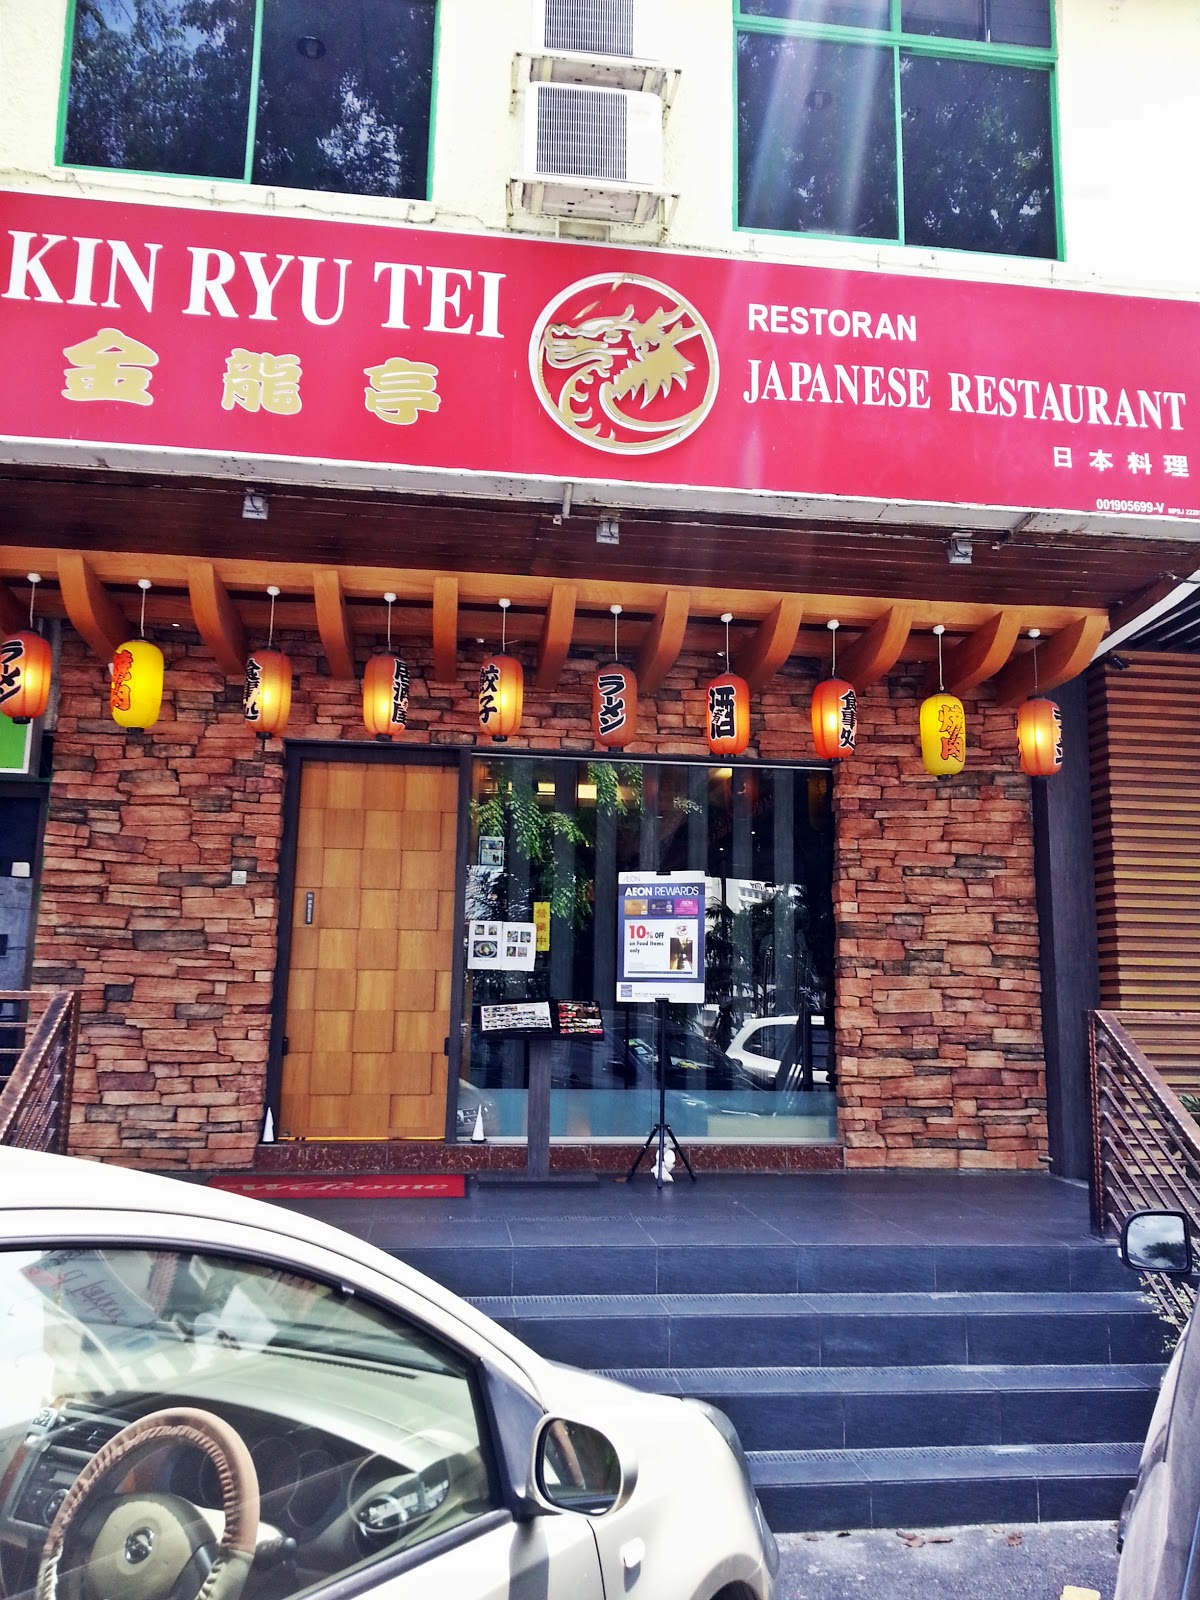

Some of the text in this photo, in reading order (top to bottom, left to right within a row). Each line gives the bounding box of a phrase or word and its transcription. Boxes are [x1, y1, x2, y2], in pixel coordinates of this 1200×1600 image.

[1, 229, 507, 339] KIN RYU TEI
[747, 303, 917, 342] RESTORAN
[60, 327, 442, 426] 金龍亭
[743, 358, 1186, 431] JAPANESE RESTAURANT
[1053, 446, 1190, 478] 日本料理
[596, 673, 627, 736] ラーメン
[624, 886, 699, 896] AEON REWARDS
[629, 925, 653, 939] 10%
